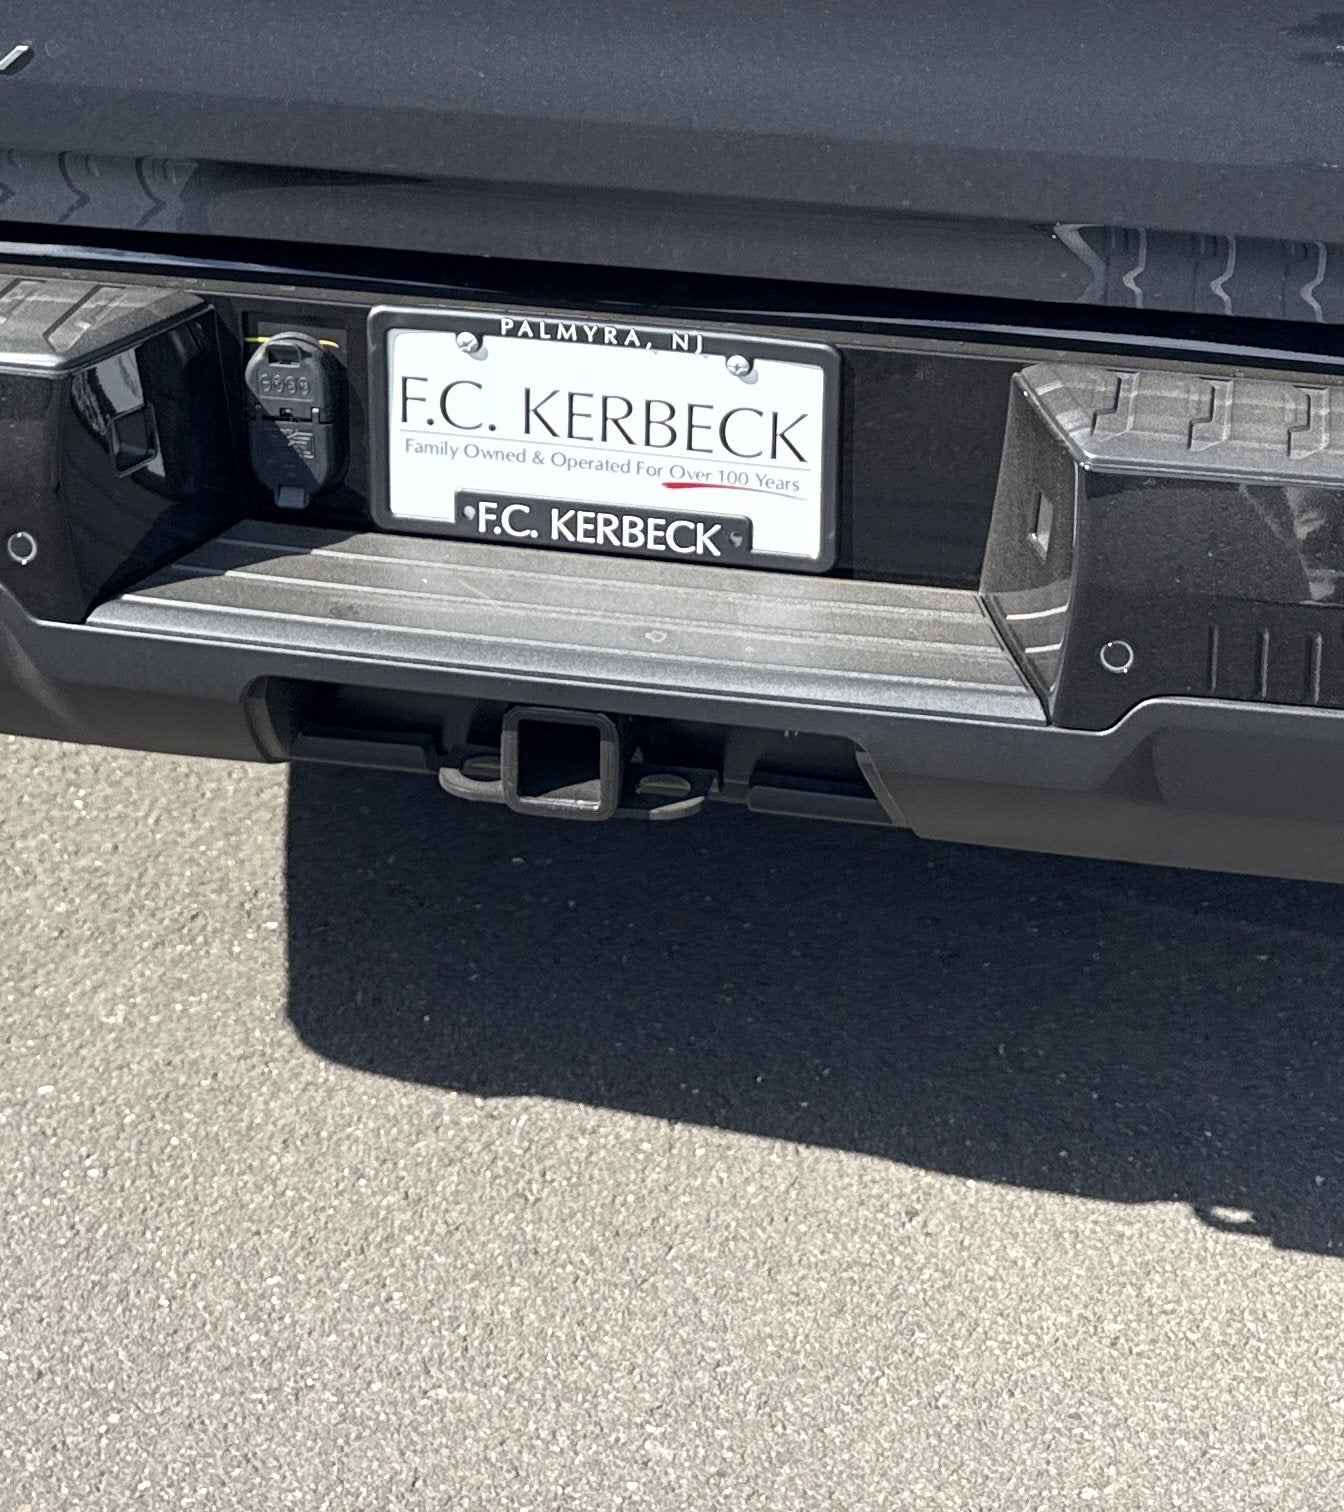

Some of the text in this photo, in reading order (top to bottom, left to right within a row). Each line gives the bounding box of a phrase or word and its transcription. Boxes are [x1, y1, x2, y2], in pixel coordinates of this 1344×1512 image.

[500, 318, 703, 354] PALMYRA, NJ
[401, 376, 809, 463] F.C. KERBECK
[405, 438, 800, 492] Family Owned & Operated For Over 100 Years
[477, 501, 722, 558] F.C. KERBECK
